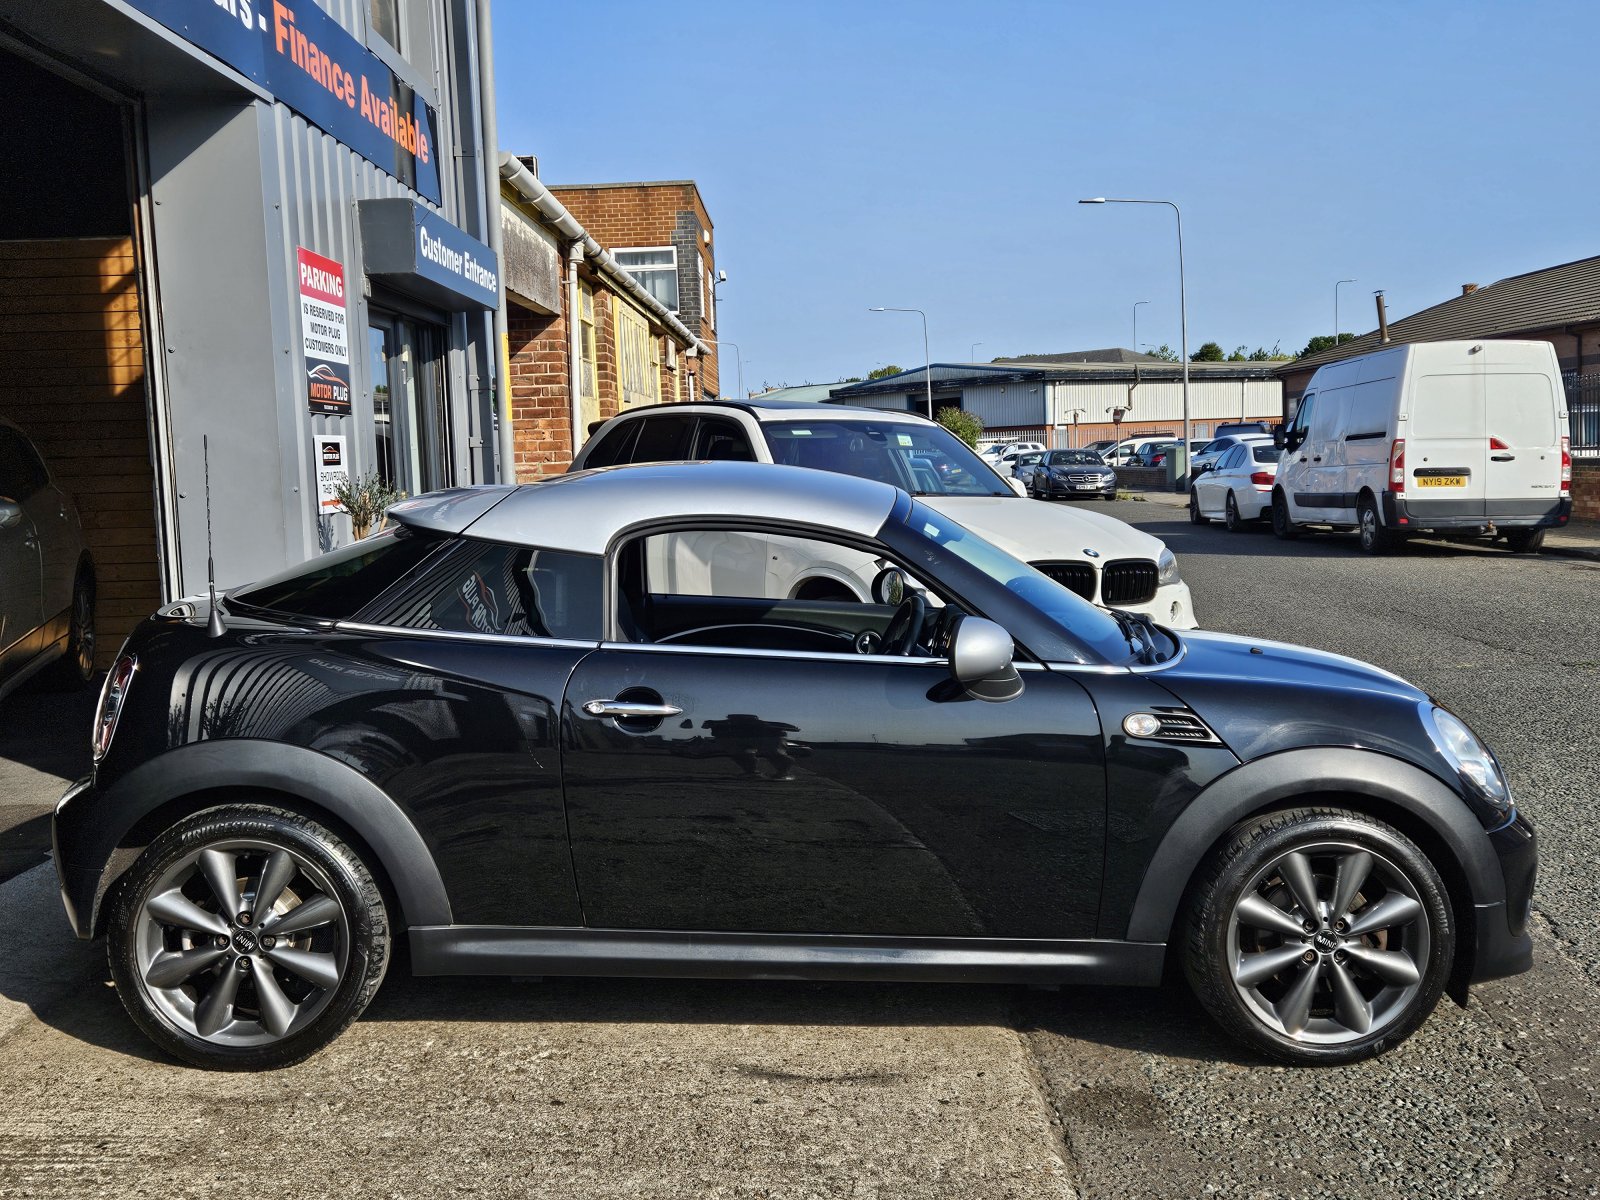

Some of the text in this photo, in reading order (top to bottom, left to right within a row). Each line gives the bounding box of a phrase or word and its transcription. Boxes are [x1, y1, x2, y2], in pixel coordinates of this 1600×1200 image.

[273, 0, 356, 108] Finance
[360, 75, 429, 164] Available
[420, 226, 497, 293] Customer Entrance
[300, 262, 343, 297] PARKING
[303, 303, 344, 325] IS RESERVED FOR
[310, 322, 341, 339] MOTOR PLUG
[305, 338, 347, 357] CUSTOMERS ONLY
[310, 382, 348, 401] MOTOR PLUG
[1422, 477, 1461, 486] NY19 ZKW
[1317, 935, 1337, 949] MINI
